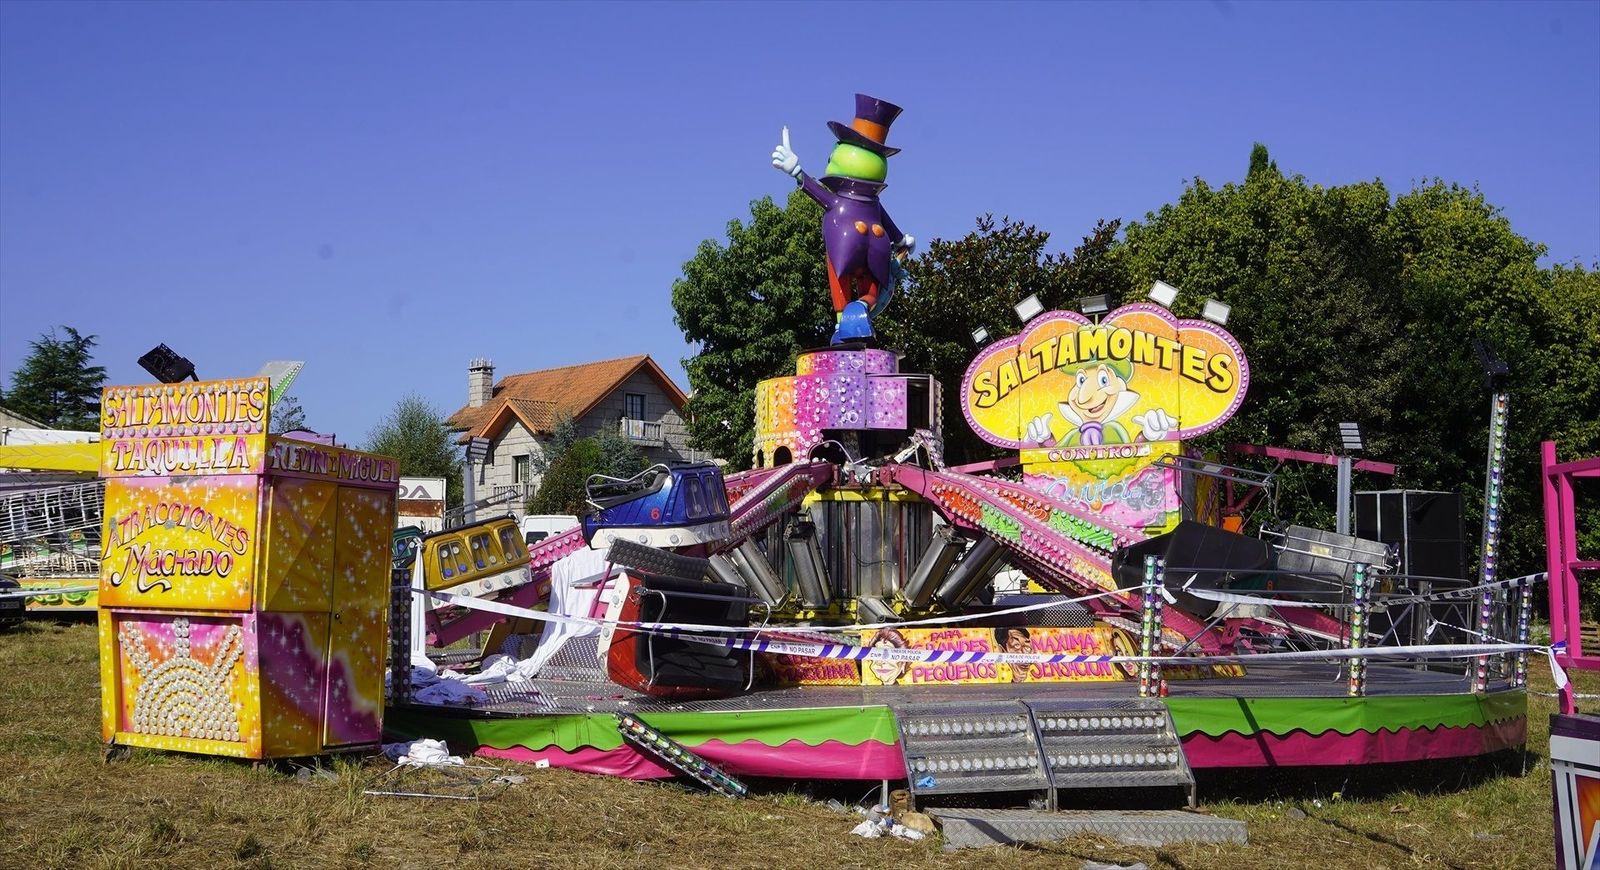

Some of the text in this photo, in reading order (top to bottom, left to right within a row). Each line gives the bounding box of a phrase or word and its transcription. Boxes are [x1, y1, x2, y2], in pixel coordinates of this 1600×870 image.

[973, 327, 1234, 409] SALTAMONTES
[103, 388, 265, 428] SALTAMONTES
[111, 437, 250, 474] TAQUILLA
[271, 444, 328, 474] KEVIN
[337, 452, 399, 482] MIGUEL
[1048, 444, 1152, 462] CONTROL
[102, 502, 250, 560] ATRACCIONES
[651, 507, 660, 520] 6
[797, 647, 816, 655] PASAR
[930, 630, 962, 641] PARA
